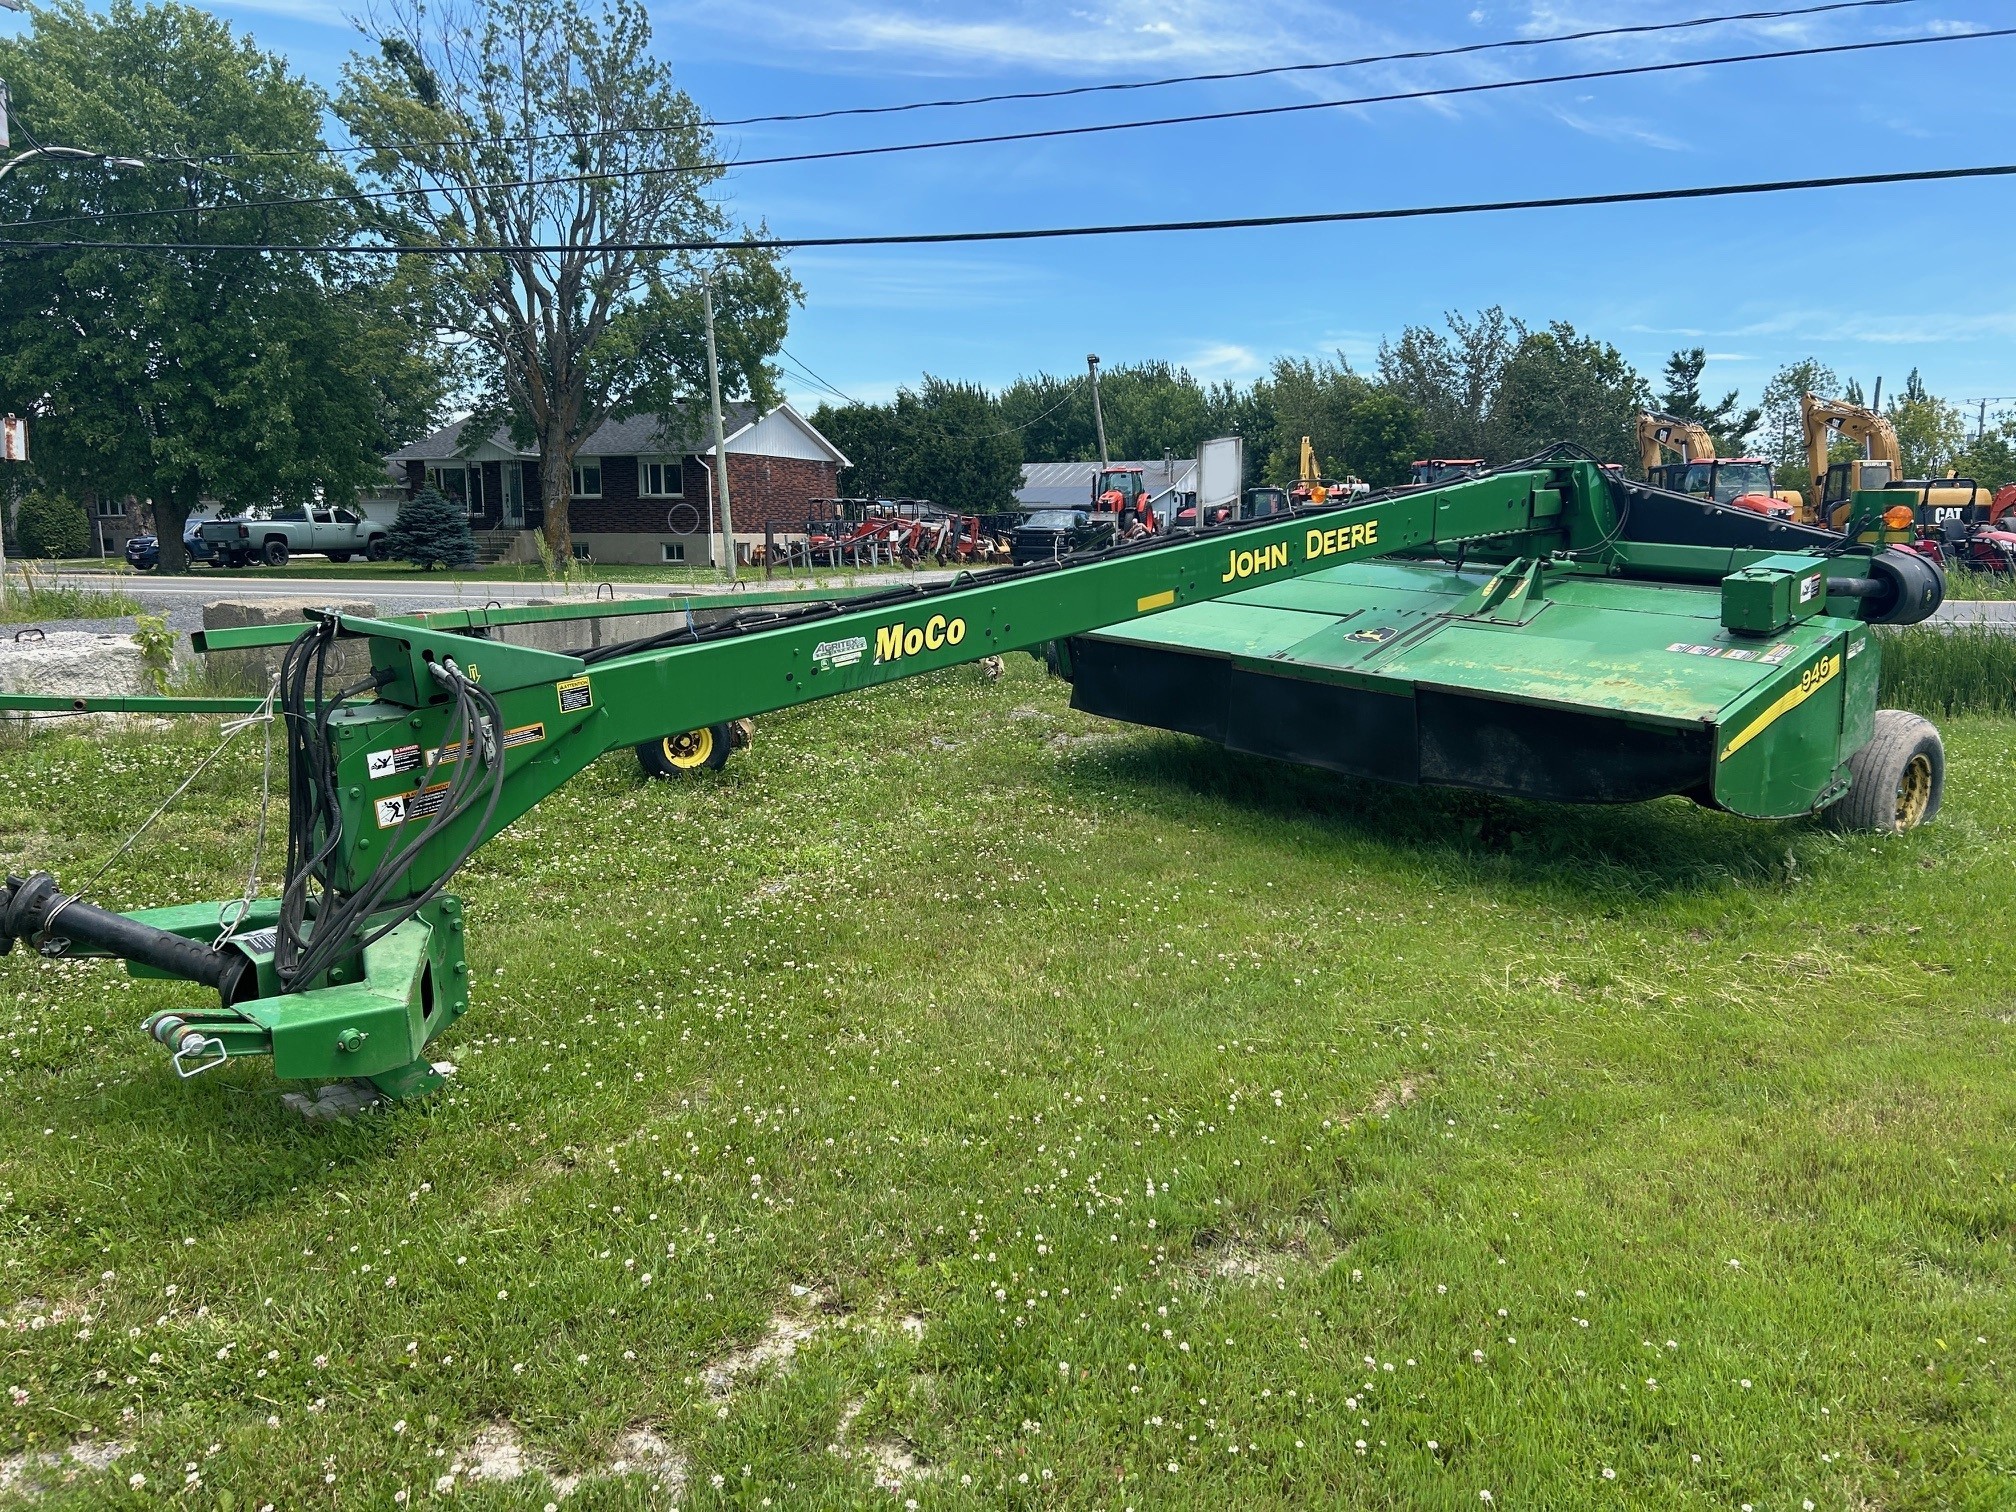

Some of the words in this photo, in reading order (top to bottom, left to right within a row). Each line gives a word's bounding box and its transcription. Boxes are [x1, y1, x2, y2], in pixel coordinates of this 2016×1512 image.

[1935, 507, 1963, 523] CAT
[1222, 541, 1287, 583] JOHN
[1306, 520, 1378, 560] DEERE
[875, 614, 966, 662] MoCo
[1802, 655, 1830, 692] 946
